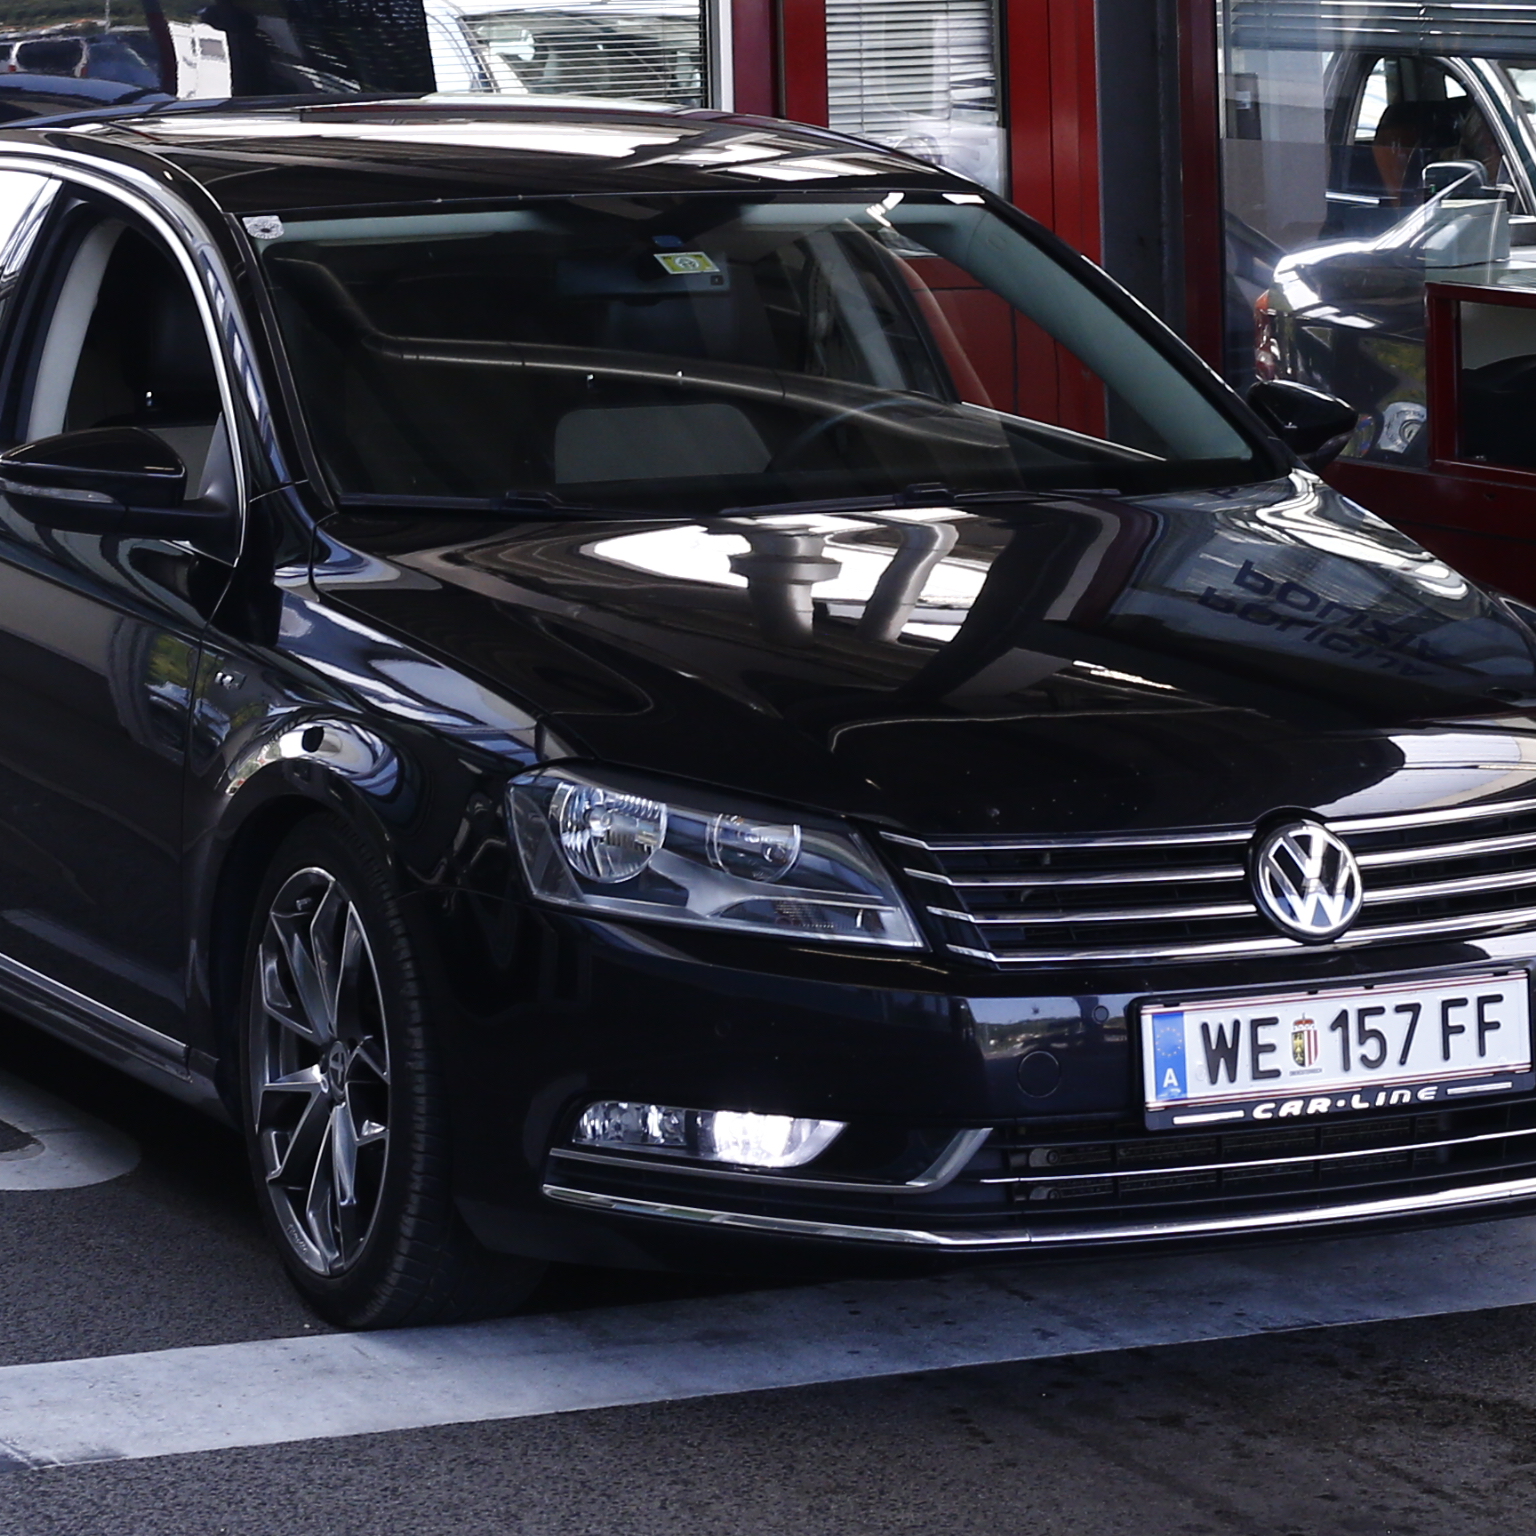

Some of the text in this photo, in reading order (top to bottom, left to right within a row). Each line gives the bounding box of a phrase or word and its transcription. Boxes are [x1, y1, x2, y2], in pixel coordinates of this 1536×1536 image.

[1200, 993, 1505, 1086] WE 157 FF
[1162, 1067, 1180, 1089] A
